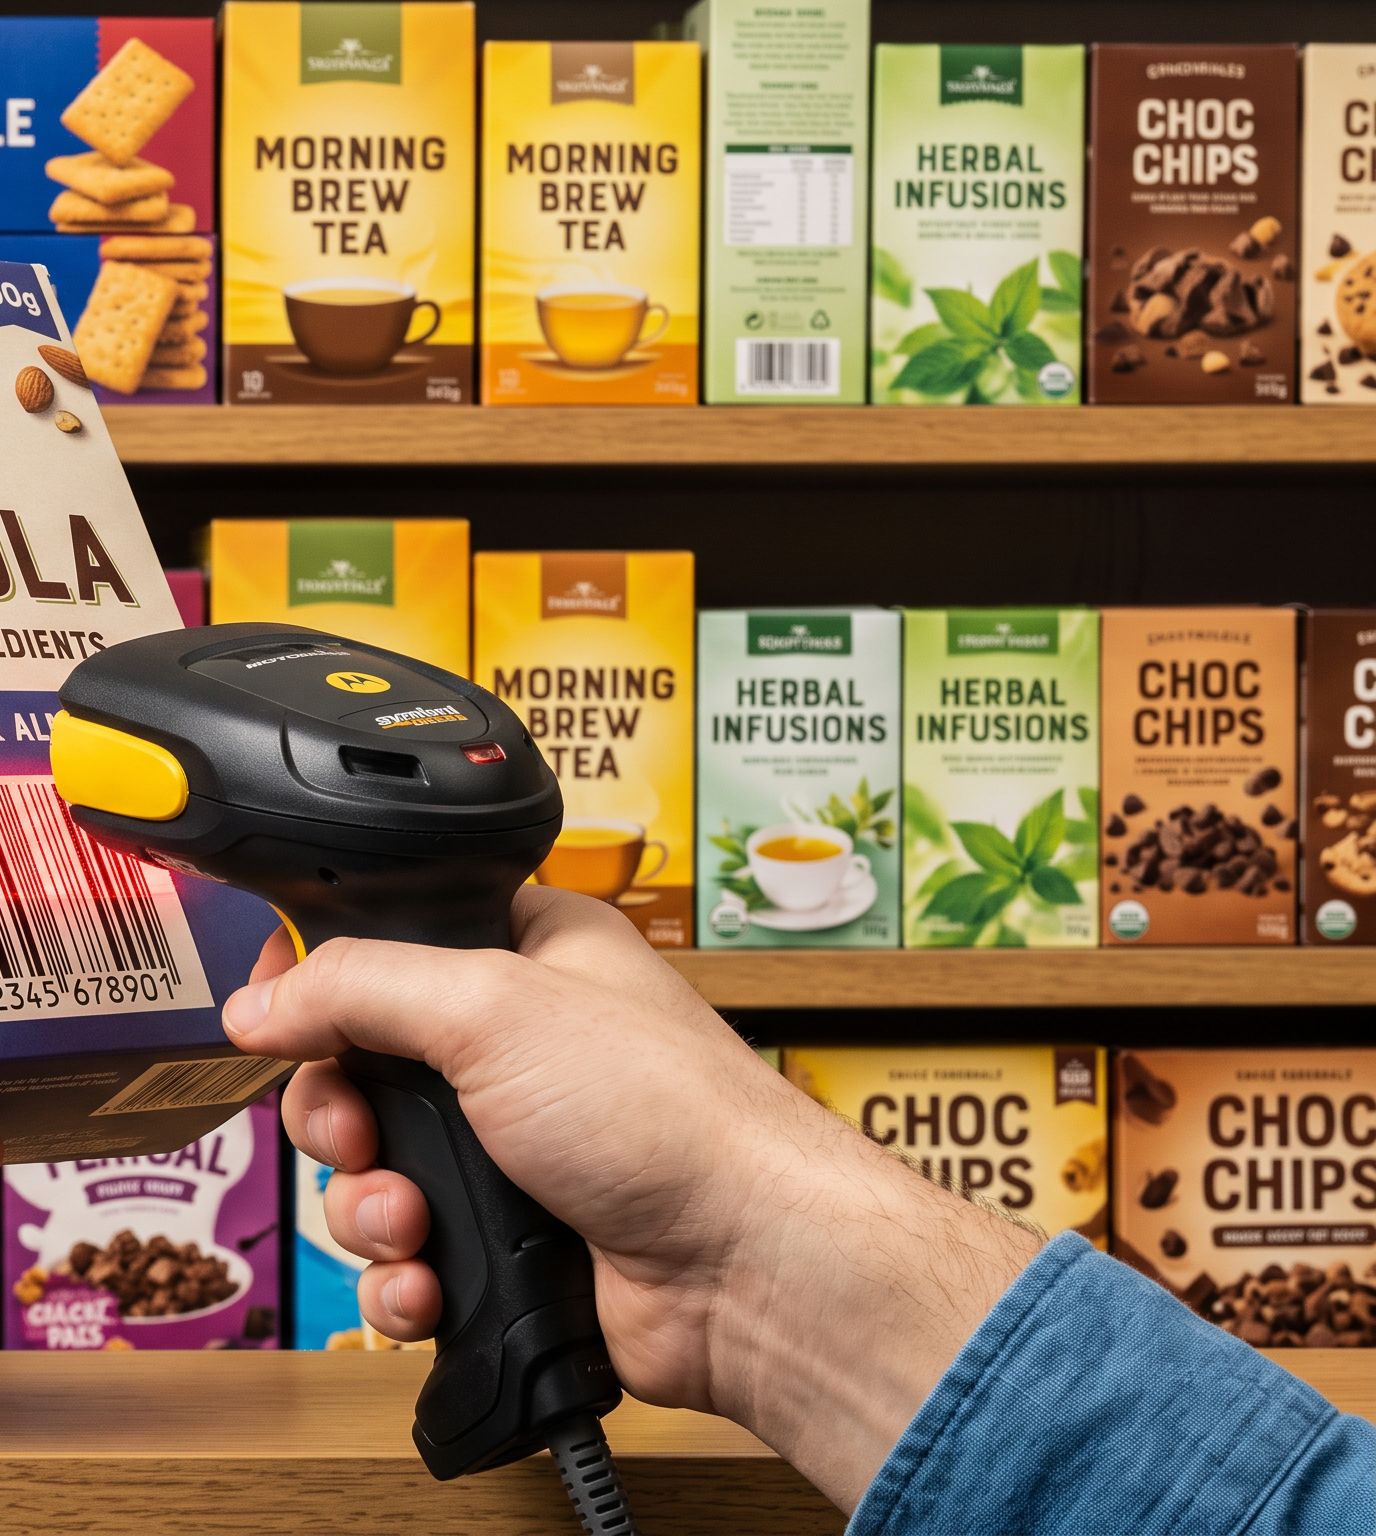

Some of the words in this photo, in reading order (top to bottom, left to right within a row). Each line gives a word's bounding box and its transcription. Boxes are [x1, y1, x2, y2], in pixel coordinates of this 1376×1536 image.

[1137, 98, 1255, 140] CHOC
[255, 136, 447, 171] MORNING
[508, 144, 679, 174] MORNING
[917, 144, 1043, 173] HERBAL
[1132, 144, 1259, 186] CHIPS
[292, 179, 410, 213] BREW
[540, 182, 646, 213] BREW
[894, 180, 1067, 209] INFUSIONS
[312, 222, 388, 255] TEA
[558, 221, 626, 252] TEA
[493, 668, 675, 699] MORNING
[736, 678, 864, 707] HERBAL
[940, 678, 1067, 707] HERBAL
[1138, 660, 1261, 701] CHOC
[529, 707, 640, 739] BREW
[712, 714, 888, 744] INFUSIONS
[916, 714, 1089, 743] INFUSIONS
[1134, 708, 1265, 748] CHIPS
[548, 747, 620, 779] TEA
[73, 972, 175, 1007] 678901
[862, 1093, 1030, 1147] CHOC
[1208, 1093, 1376, 1148] CHOC
[1202, 1157, 1376, 1213] CHIPS
